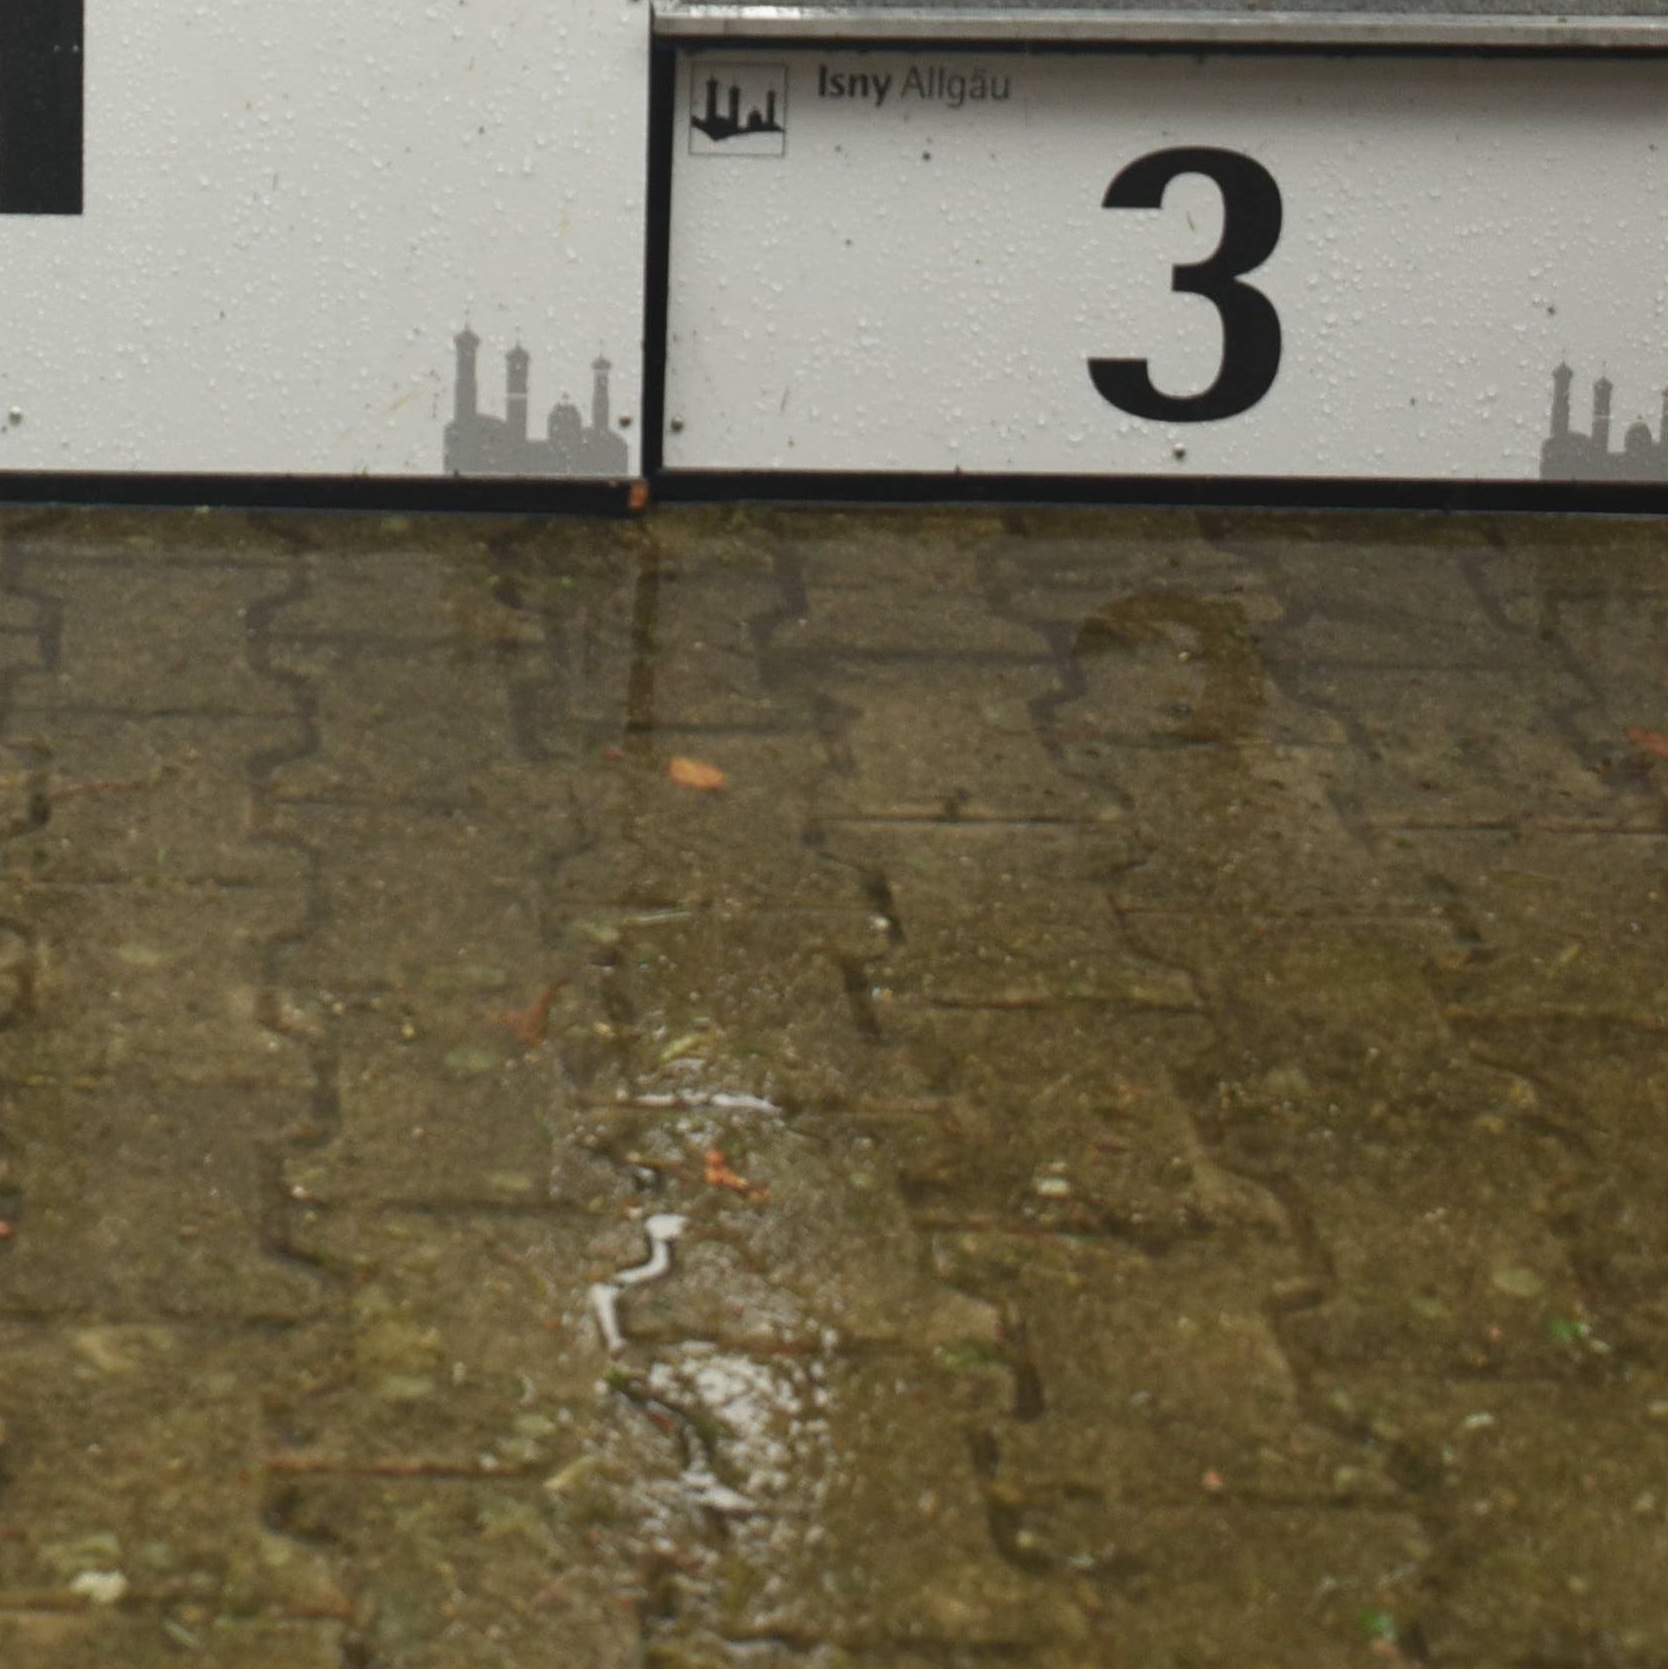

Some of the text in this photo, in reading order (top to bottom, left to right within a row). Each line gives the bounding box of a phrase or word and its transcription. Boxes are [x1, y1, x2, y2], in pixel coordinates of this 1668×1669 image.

[817, 64, 1020, 109] Isny Allgäu
[1087, 145, 1283, 422] 3
